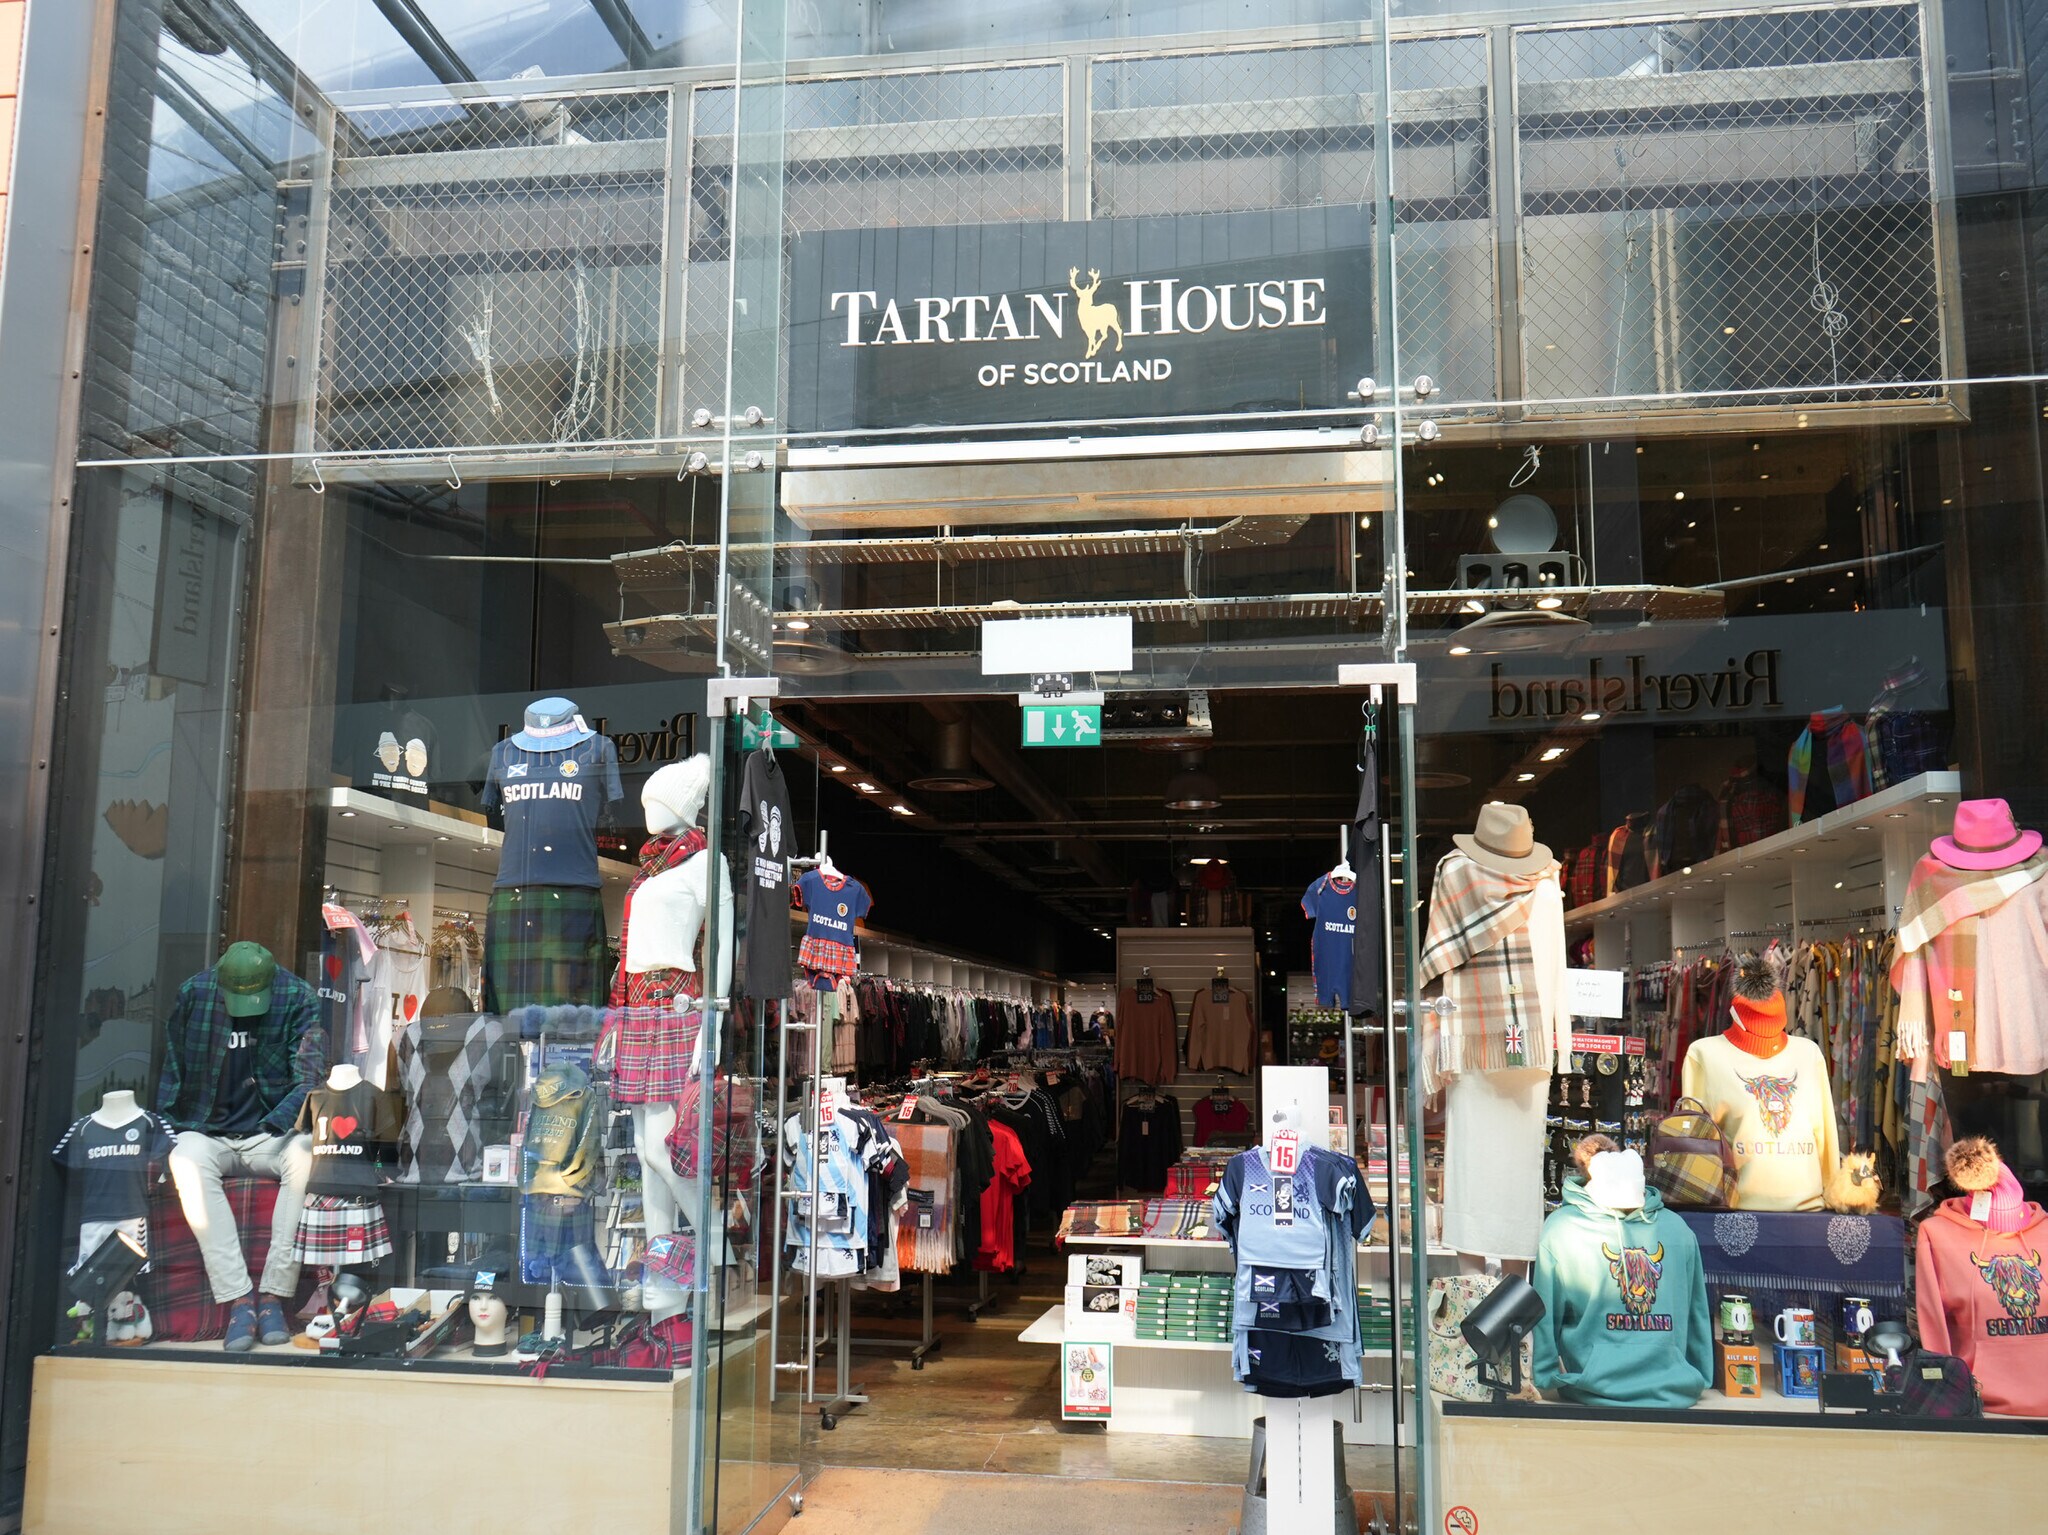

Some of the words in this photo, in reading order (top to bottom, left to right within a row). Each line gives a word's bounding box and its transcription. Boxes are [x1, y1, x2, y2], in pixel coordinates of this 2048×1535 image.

[831, 291, 1068, 347] TARTAN
[1122, 278, 1327, 336] HOUSE
[978, 364, 1015, 387] OF
[1024, 358, 1172, 385] SCOTLAND
[503, 782, 582, 803] SCOTLAND
[812, 913, 848, 931] SCOTLAND
[1325, 921, 1355, 934] SCOTLAN
[1008, 1083, 1017, 1091] 20
[820, 1106, 833, 1122] 15
[902, 1106, 912, 1117] 15
[318, 1116, 329, 1141] I
[87, 1144, 141, 1160] SCOTLAND
[1735, 1141, 1815, 1156] SCOTLAND
[1249, 1203, 1311, 1219] SCOND
[1254, 1285, 1275, 1293] SCOTLAND
[1605, 1312, 1673, 1331] SCOTLAND
[1986, 1317, 2048, 1336] SCOTLAN
